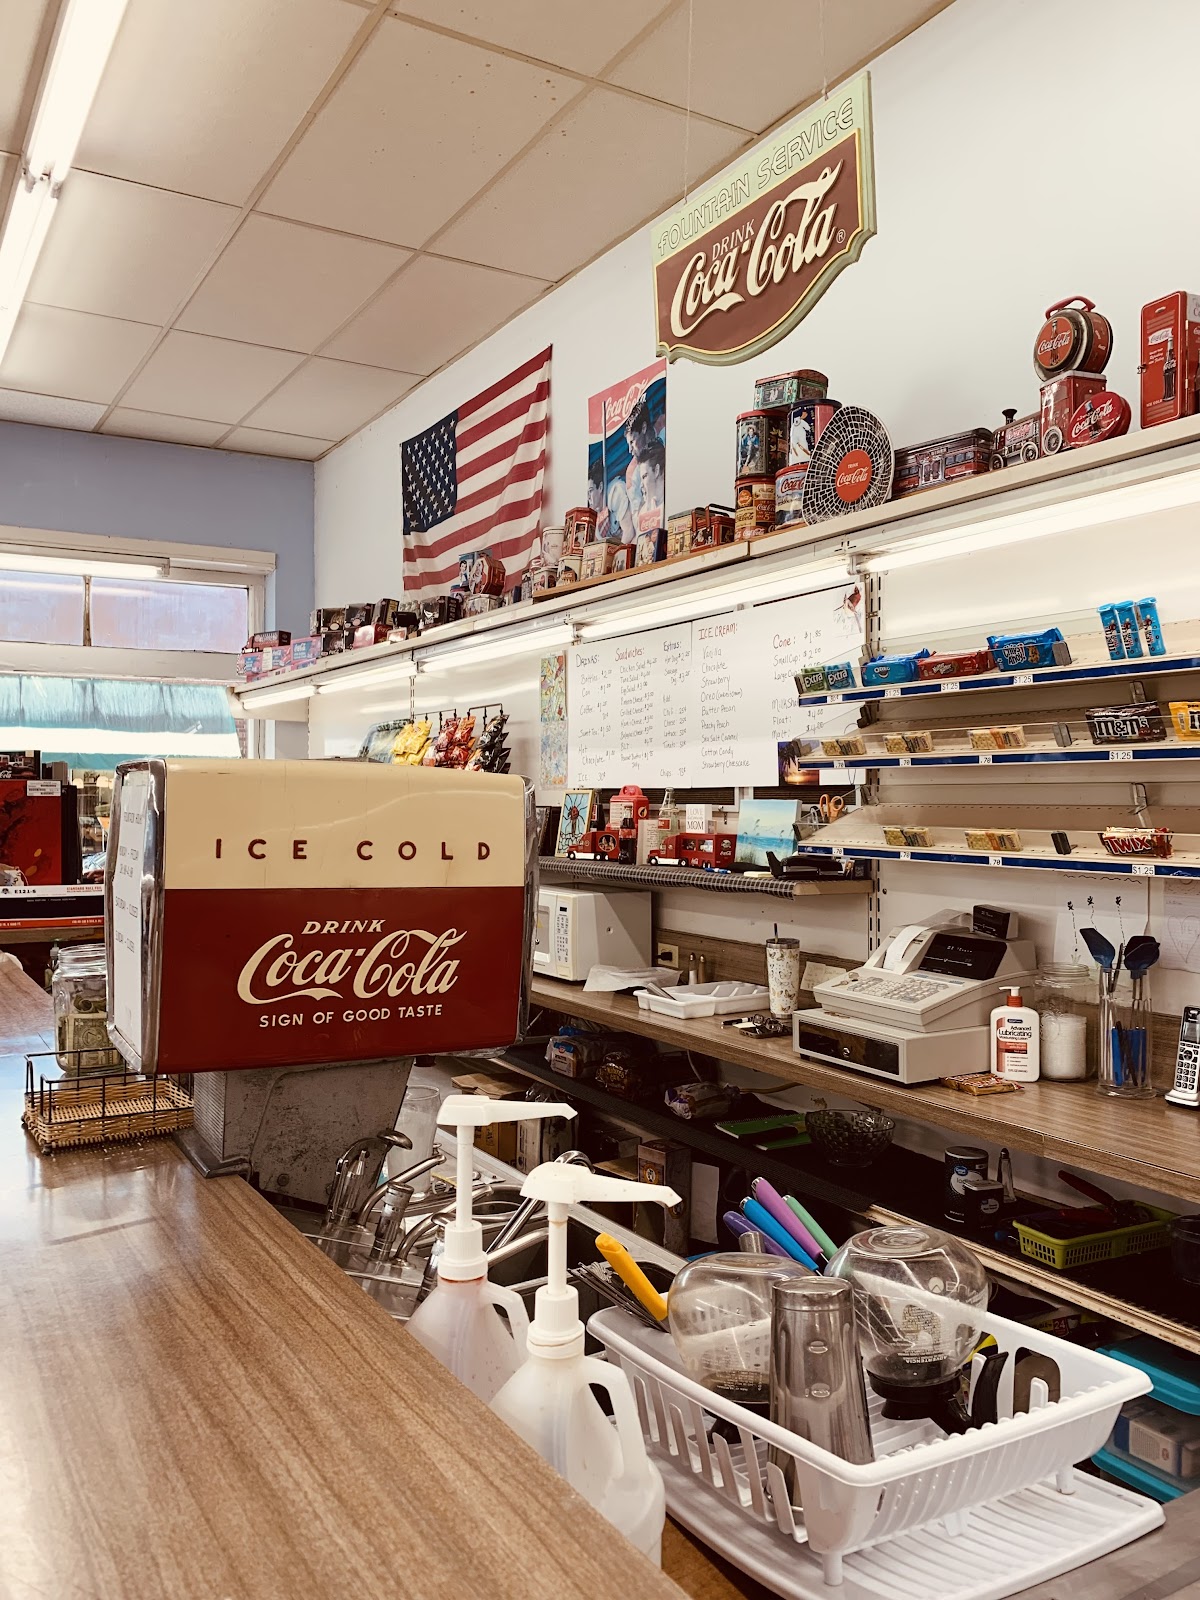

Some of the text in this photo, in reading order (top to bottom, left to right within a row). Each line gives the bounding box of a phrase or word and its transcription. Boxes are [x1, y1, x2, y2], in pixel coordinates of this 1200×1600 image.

[658, 97, 854, 257] FOUNTAIN SERVICE
[670, 158, 845, 338] Coca-Cola
[712, 218, 754, 262] DRINK
[1037, 329, 1071, 356] Coca-Cola
[1071, 398, 1114, 438] Coca-Cola
[836, 466, 870, 488] Coca-Cola
[698, 627, 714, 640] ICE
[804, 672, 823, 687] Extra
[827, 668, 847, 685] Extra
[1014, 675, 1032, 684] $1.25
[885, 689, 900, 697] $1.25
[1110, 751, 1132, 760] $1.25
[690, 807, 704, 816] LOVE
[686, 820, 704, 830] MOM
[215, 838, 491, 861] ICE COLD
[1103, 835, 1152, 854] TWIX
[1132, 866, 1154, 875] $1.25
[301, 919, 386, 935] DRINK
[236, 927, 468, 1005] Coca-Cola
[259, 1004, 443, 1028] SIGN OF GOOD TASTE
[998, 1029, 1032, 1039] Lubricating
[1054, 1319, 1066, 1329] 24
